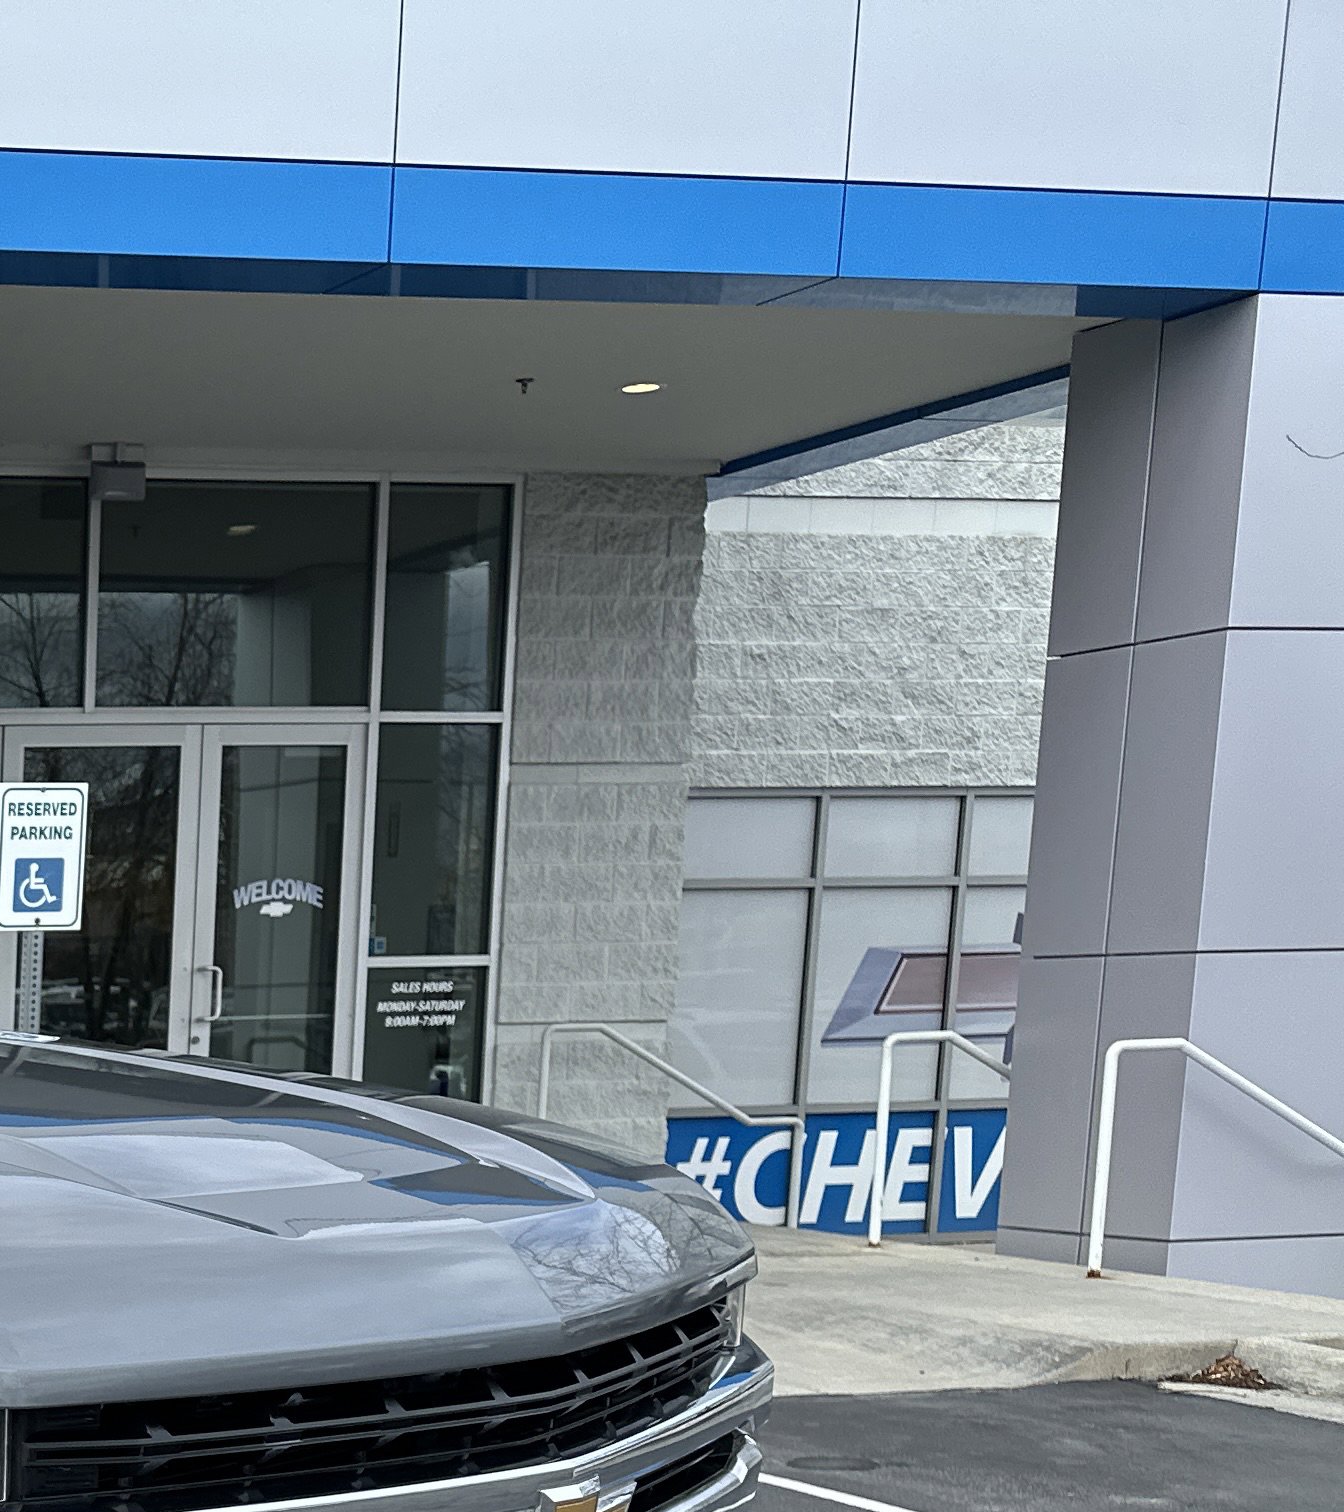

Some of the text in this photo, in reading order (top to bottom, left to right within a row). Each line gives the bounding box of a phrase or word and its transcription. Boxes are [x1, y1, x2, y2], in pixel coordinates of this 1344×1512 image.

[8, 802, 78, 818] RESERVED
[10, 826, 74, 841] PARKING
[233, 879, 324, 909] WELCOME
[391, 981, 454, 993] SALES HOURS
